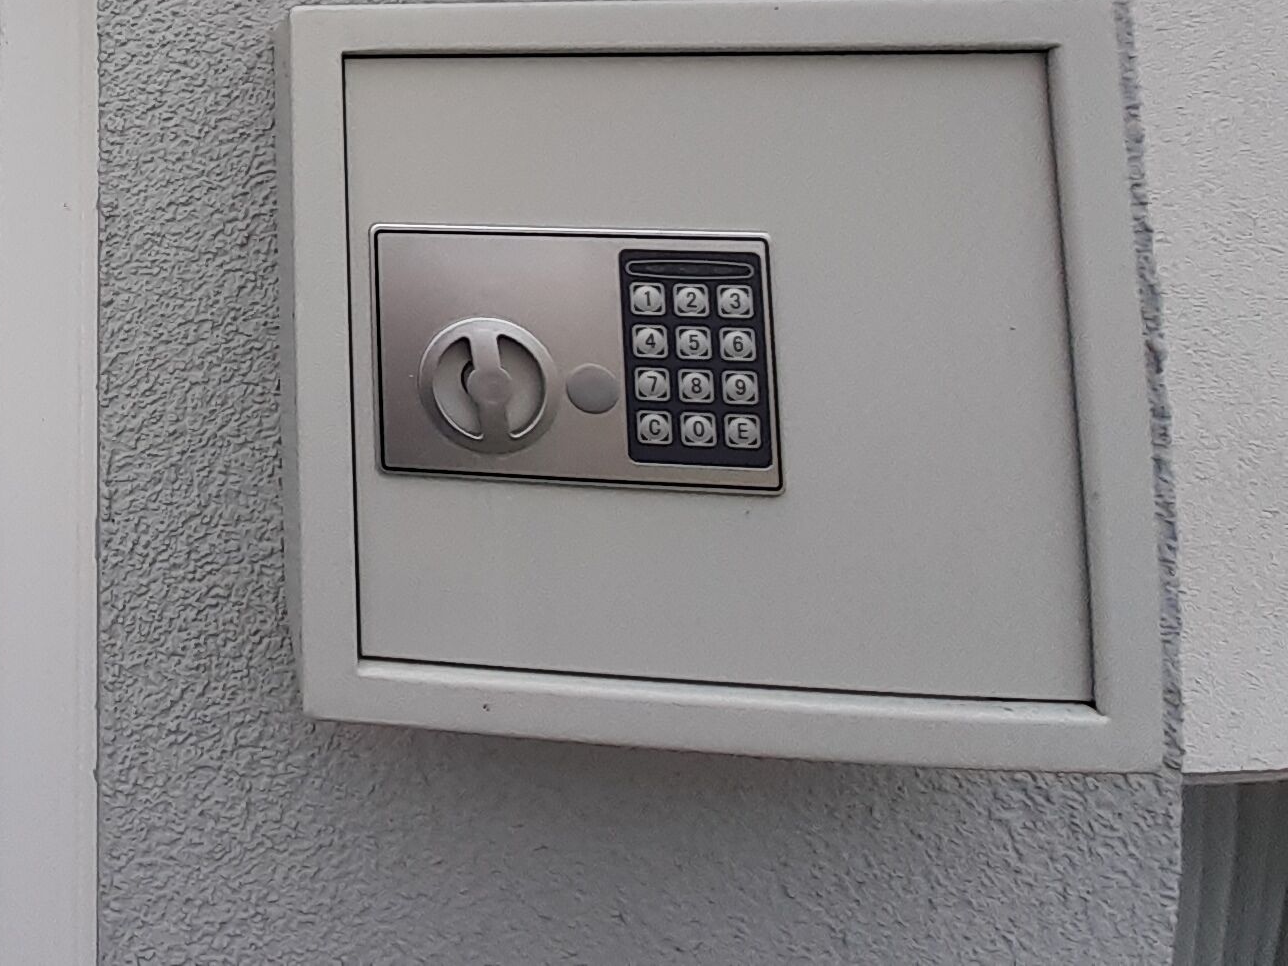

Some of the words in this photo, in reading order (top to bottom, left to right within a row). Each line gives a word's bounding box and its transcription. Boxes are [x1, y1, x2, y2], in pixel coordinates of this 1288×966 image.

[644, 290, 652, 307] 1
[686, 291, 697, 308] 2
[730, 293, 741, 309] 3
[645, 333, 656, 349] 4
[688, 334, 699, 351] 5
[732, 336, 744, 353] 6
[647, 376, 658, 393] 7
[691, 377, 702, 394] 8
[735, 379, 746, 395] 9
[649, 419, 660, 436] C
[693, 420, 704, 437] 0
[737, 422, 749, 439] E
